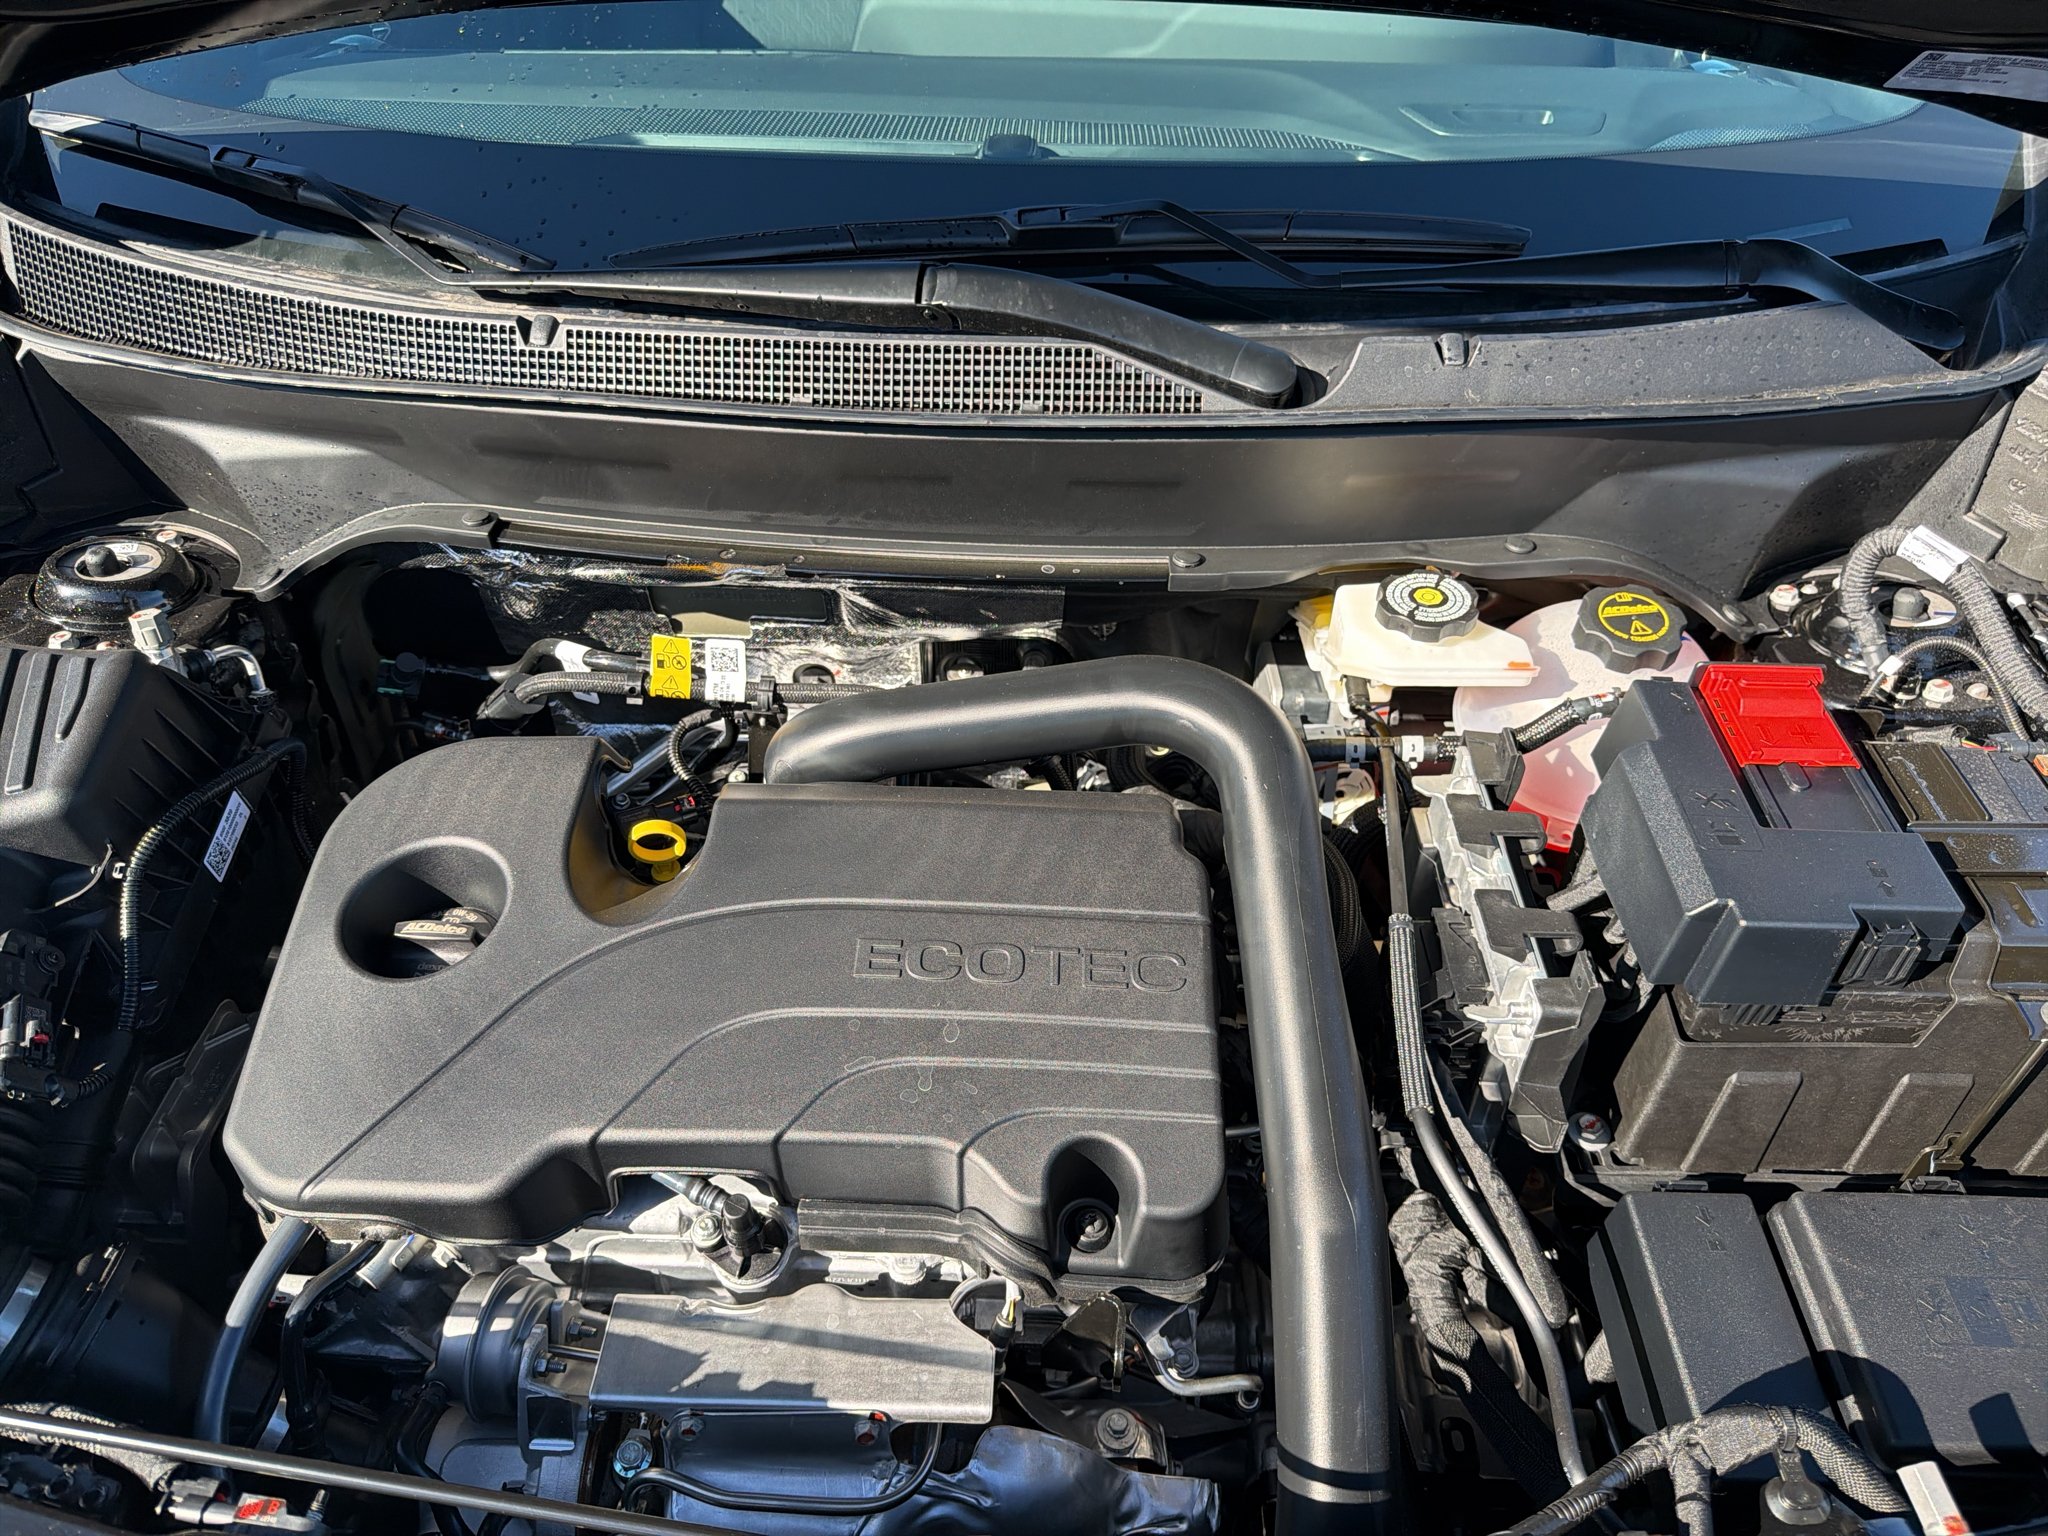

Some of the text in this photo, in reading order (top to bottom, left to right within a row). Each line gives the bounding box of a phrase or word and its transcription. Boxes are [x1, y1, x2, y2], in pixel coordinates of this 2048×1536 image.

[1602, 604, 1659, 615] ACDelco
[453, 909, 478, 922] 0W-20
[400, 922, 468, 934] ACDelco
[853, 938, 1187, 992] ECOTEC
